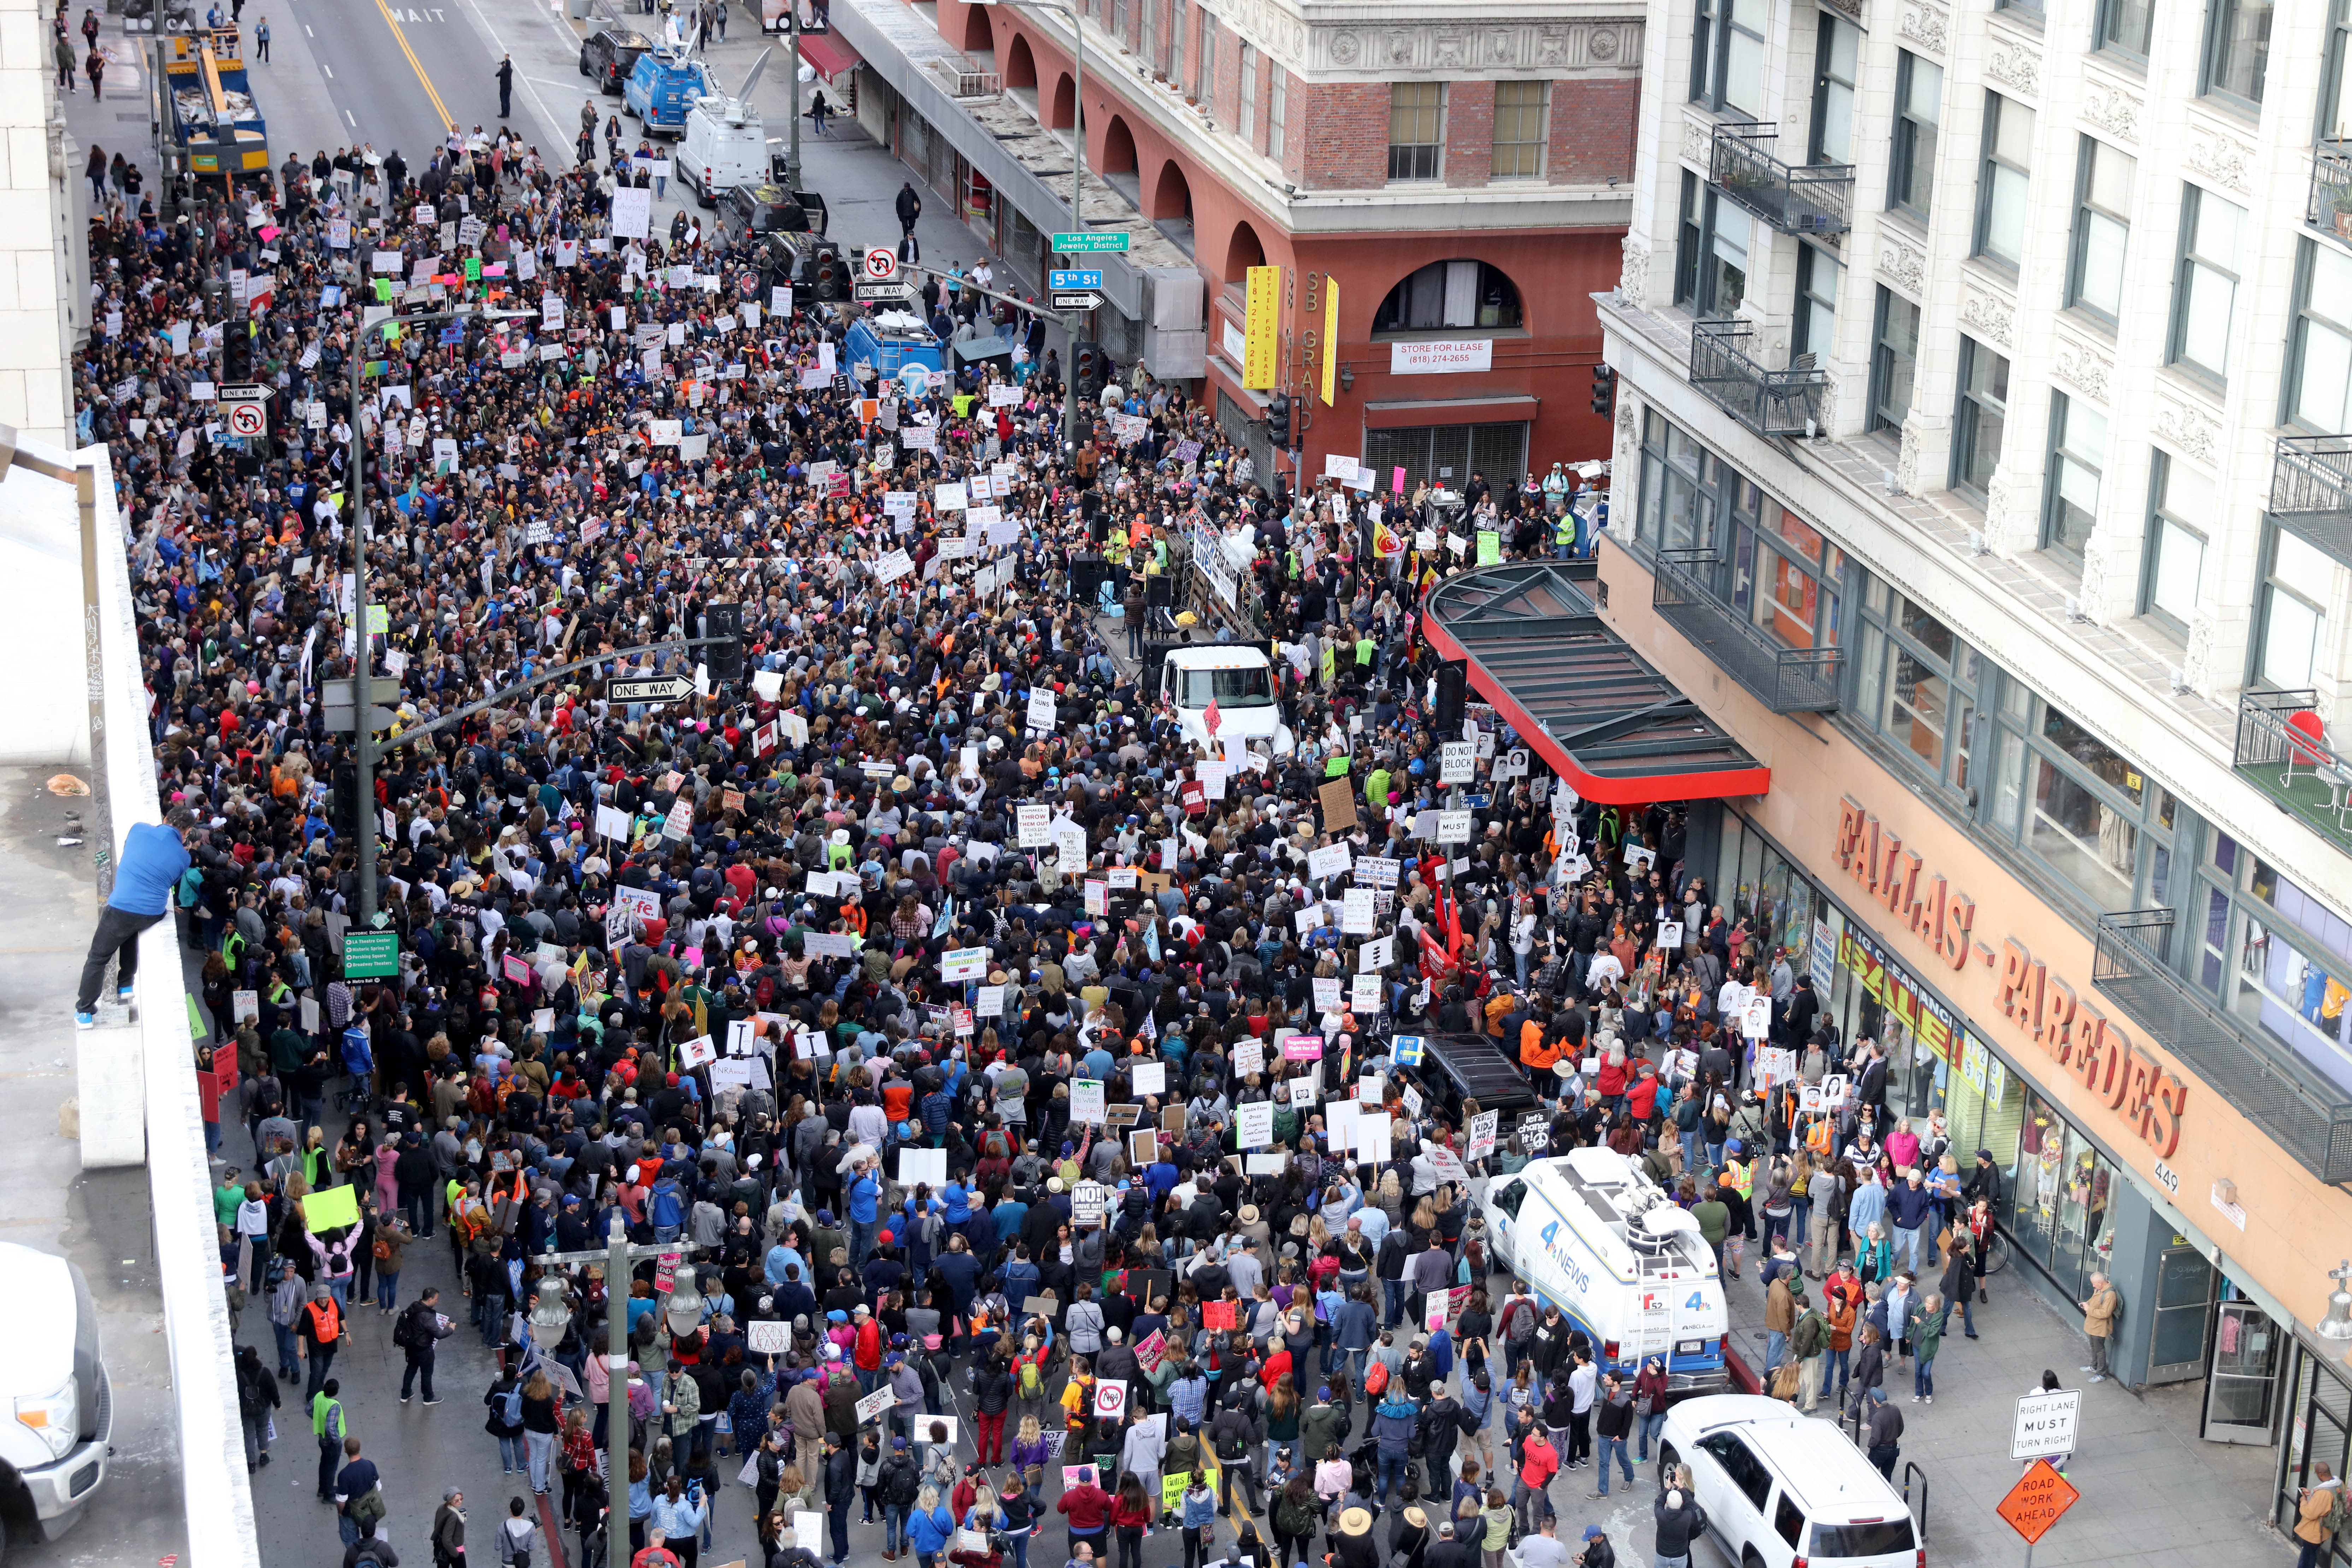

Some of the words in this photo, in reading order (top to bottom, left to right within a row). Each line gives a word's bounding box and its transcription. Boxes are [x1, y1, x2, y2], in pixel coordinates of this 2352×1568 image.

[389, 8, 445, 23] WAIT
[616, 188, 648, 202] STOP
[615, 203, 646, 217] Whoring
[622, 213, 633, 221] the
[616, 222, 643, 236] NRA
[859, 287, 877, 296] ONE
[884, 286, 902, 295] WAY
[1305, 271, 1319, 312] SB
[1401, 345, 1431, 353] STORE
[1409, 356, 1430, 364] (818)
[1432, 354, 1469, 363] 274-2655
[1301, 329, 1316, 430] GRAND
[527, 527, 550, 537] MANY
[529, 521, 547, 530] HOW
[527, 533, 554, 544] MORE?
[1196, 525, 1215, 558] MARCH
[1214, 549, 1225, 570] FOR
[1225, 560, 1237, 585] OUR
[1196, 543, 1212, 577] LIVES
[614, 685, 639, 697] ONE
[649, 683, 674, 694] WAY
[1029, 718, 1051, 727] ENOUGH
[1446, 747, 1456, 756] DO
[1458, 746, 1473, 755] NOT
[1445, 759, 1472, 768] BLOCK
[1183, 790, 1199, 800] NEVER
[1185, 795, 1203, 806] AGAIN
[1822, 941, 1832, 960] HIRING
[1817, 950, 1833, 973] POSITIONS
[1831, 795, 1975, 970] FALLAS
[1993, 937, 2187, 1158] PAREDES
[1353, 1001, 1379, 1011] thermostat?
[1473, 1110, 1497, 1124] PROTECT
[1526, 1113, 1544, 1124] let's
[1475, 1120, 1494, 1133] KIDS
[1517, 1120, 1550, 1133] change
[1477, 1131, 1491, 1139] NOT
[1521, 1131, 1533, 1144] it!
[1470, 1135, 1495, 1150] GUNS
[2155, 1163, 2178, 1192] 449
[1556, 1250, 1589, 1293] NEWS
[1428, 1290, 1448, 1300] ENOUGH
[1427, 1303, 1447, 1313] ENOUGH
[749, 1325, 791, 1337] ASSAULT
[750, 1338, 791, 1350] WEAPONS
[858, 1390, 885, 1409] #NEVER
[866, 1393, 887, 1407] AGAIN
[2020, 1404, 2048, 1415] RIGHT
[2051, 1401, 2075, 1411] LANE
[2024, 1418, 2067, 1432] MUST
[2016, 1439, 2040, 1449] TURN
[2044, 1435, 2072, 1445] RIGHT
[2023, 1478, 2054, 1492] ROAD
[2021, 1493, 2053, 1505] WORK
[2015, 1508, 2055, 1522] AHEAD
